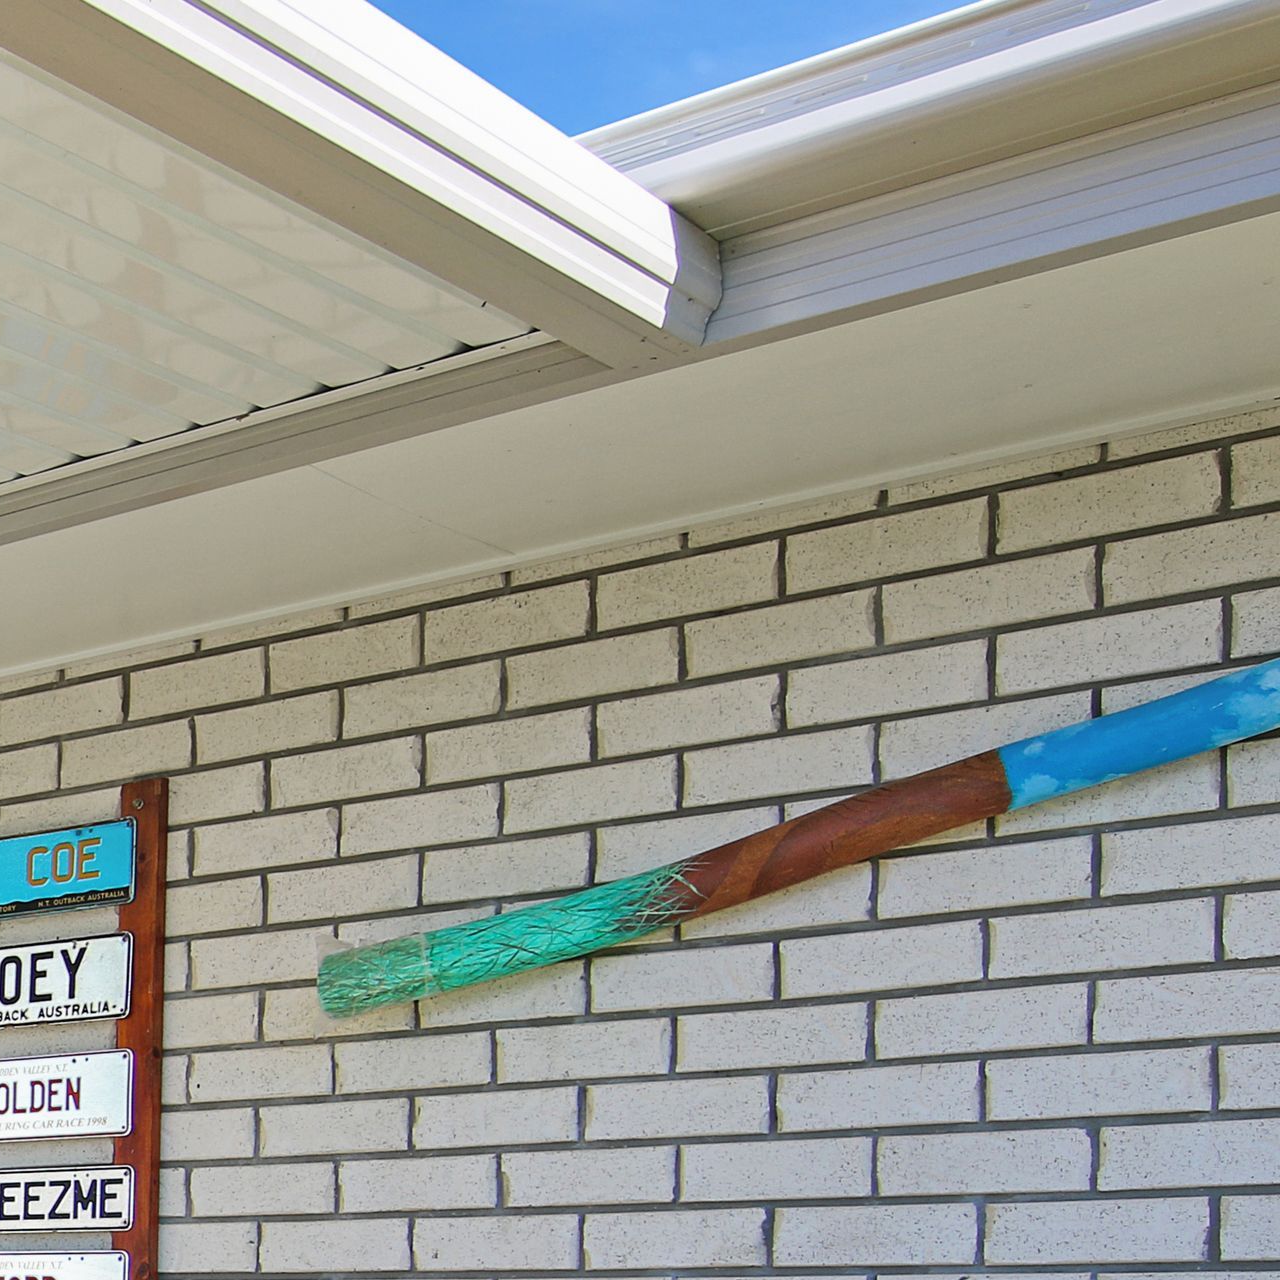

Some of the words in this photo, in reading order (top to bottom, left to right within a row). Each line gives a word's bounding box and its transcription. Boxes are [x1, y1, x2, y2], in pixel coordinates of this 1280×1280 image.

[27, 838, 102, 887] COE
[53, 895, 86, 906] OUTBACK
[87, 890, 125, 900] AUSTRALIA
[32, 1119, 54, 1129] CAR
[55, 1117, 85, 1128] RACE
[86, 1116, 108, 1126] 1998
